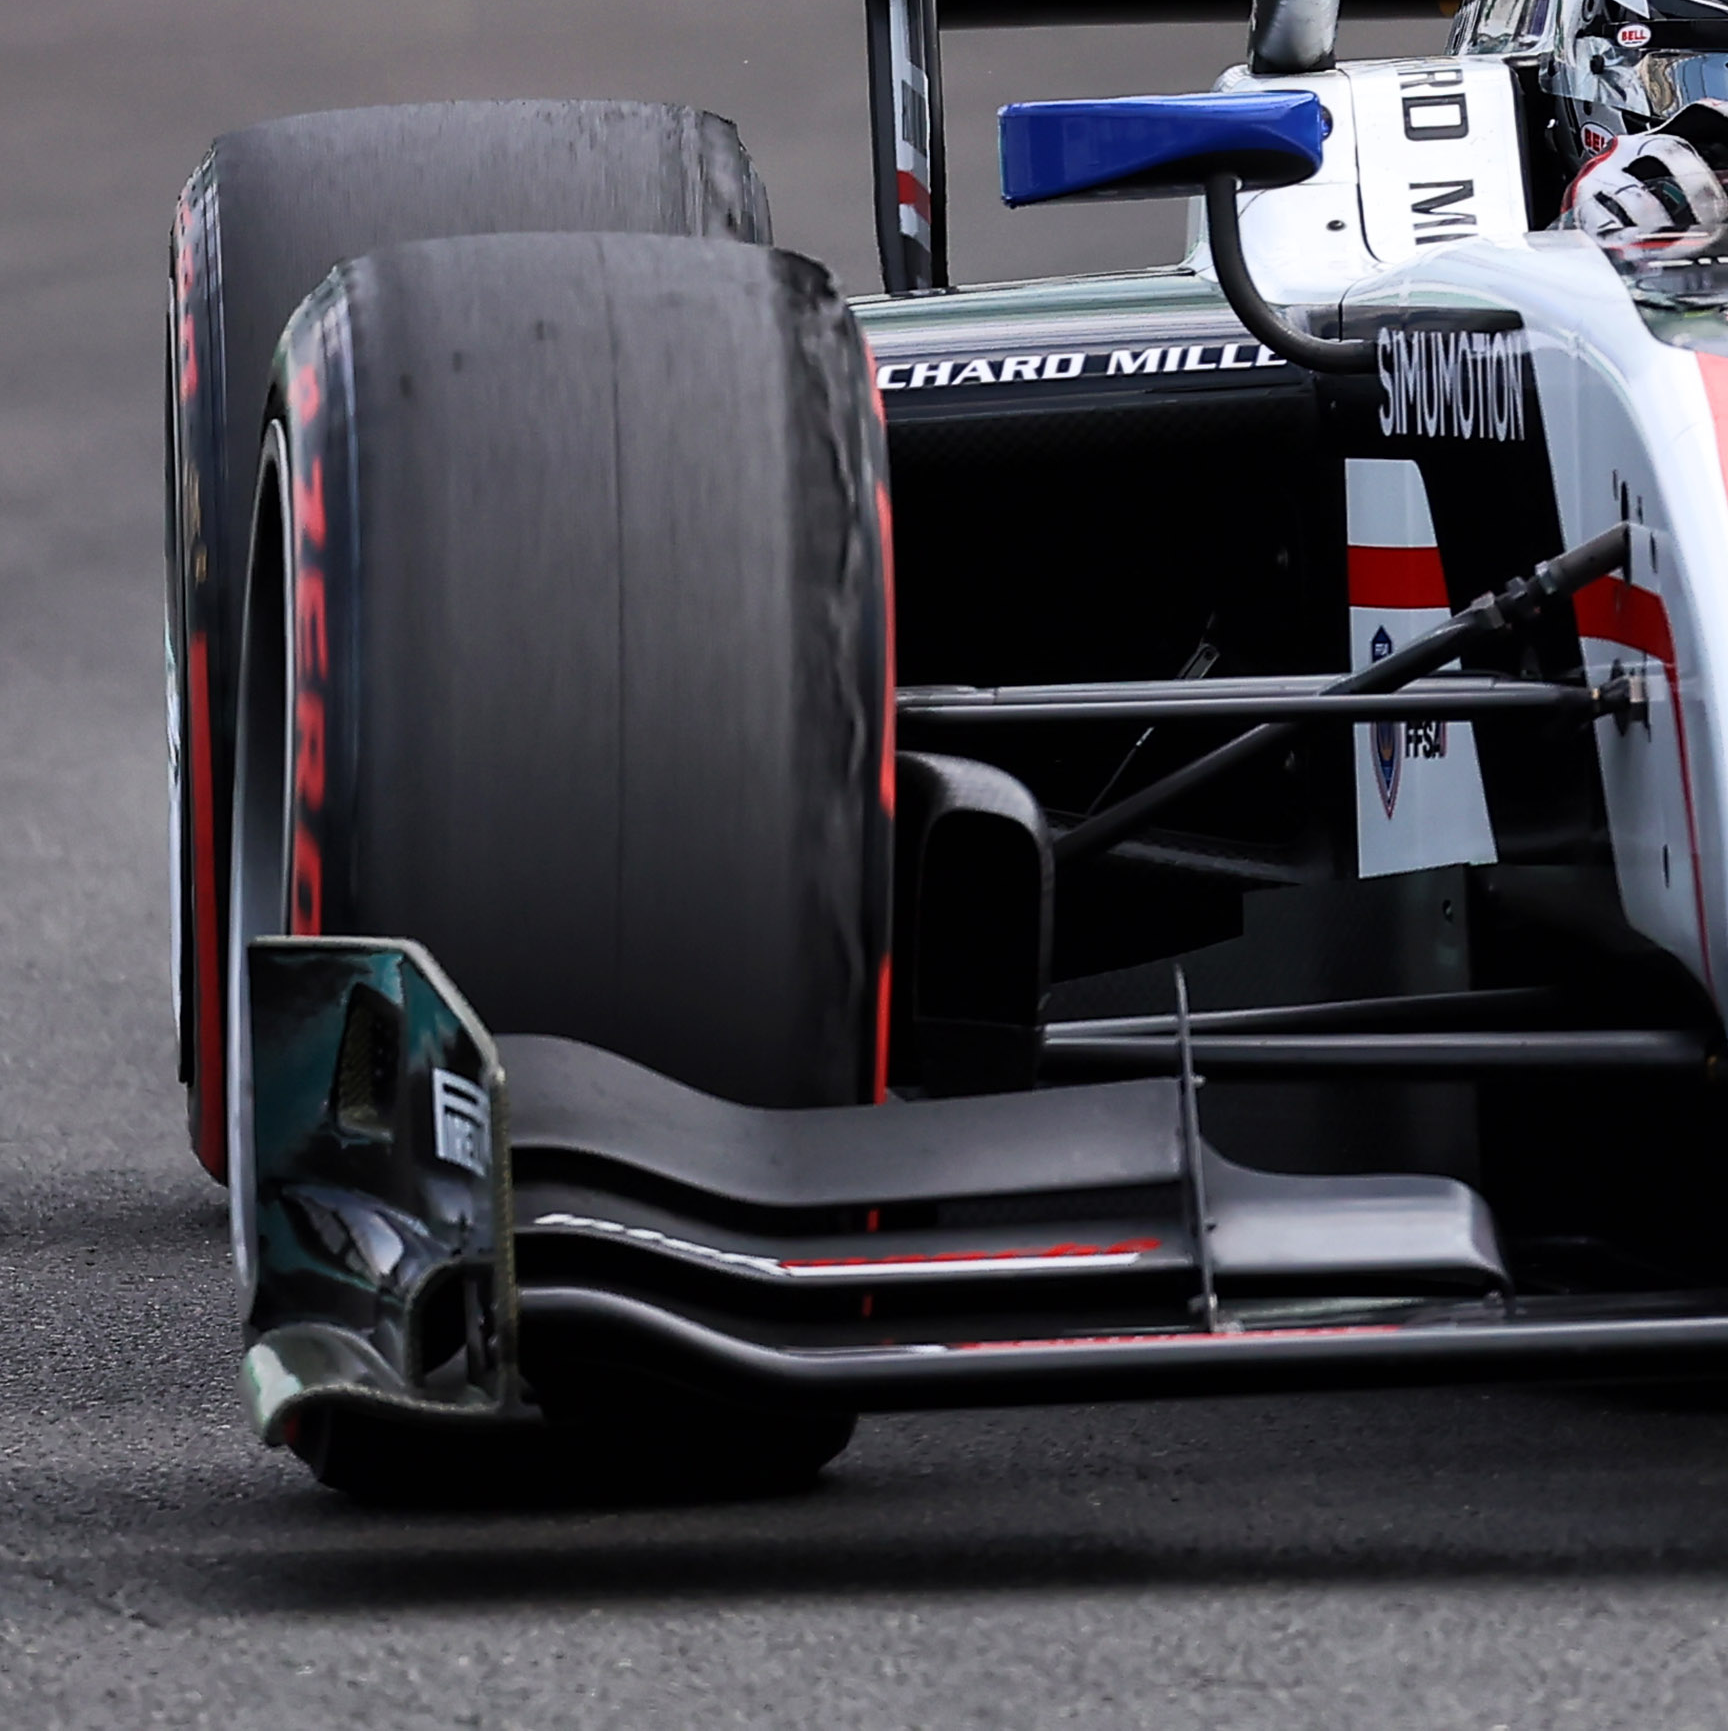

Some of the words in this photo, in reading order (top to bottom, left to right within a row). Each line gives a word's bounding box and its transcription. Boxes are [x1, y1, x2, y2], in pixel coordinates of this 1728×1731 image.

[1621, 30, 1648, 41] BELL
[876, 352, 1087, 391] CHARD
[1105, 343, 1288, 377] MILLE
[1377, 326, 1525, 442] SIMUMOTION
